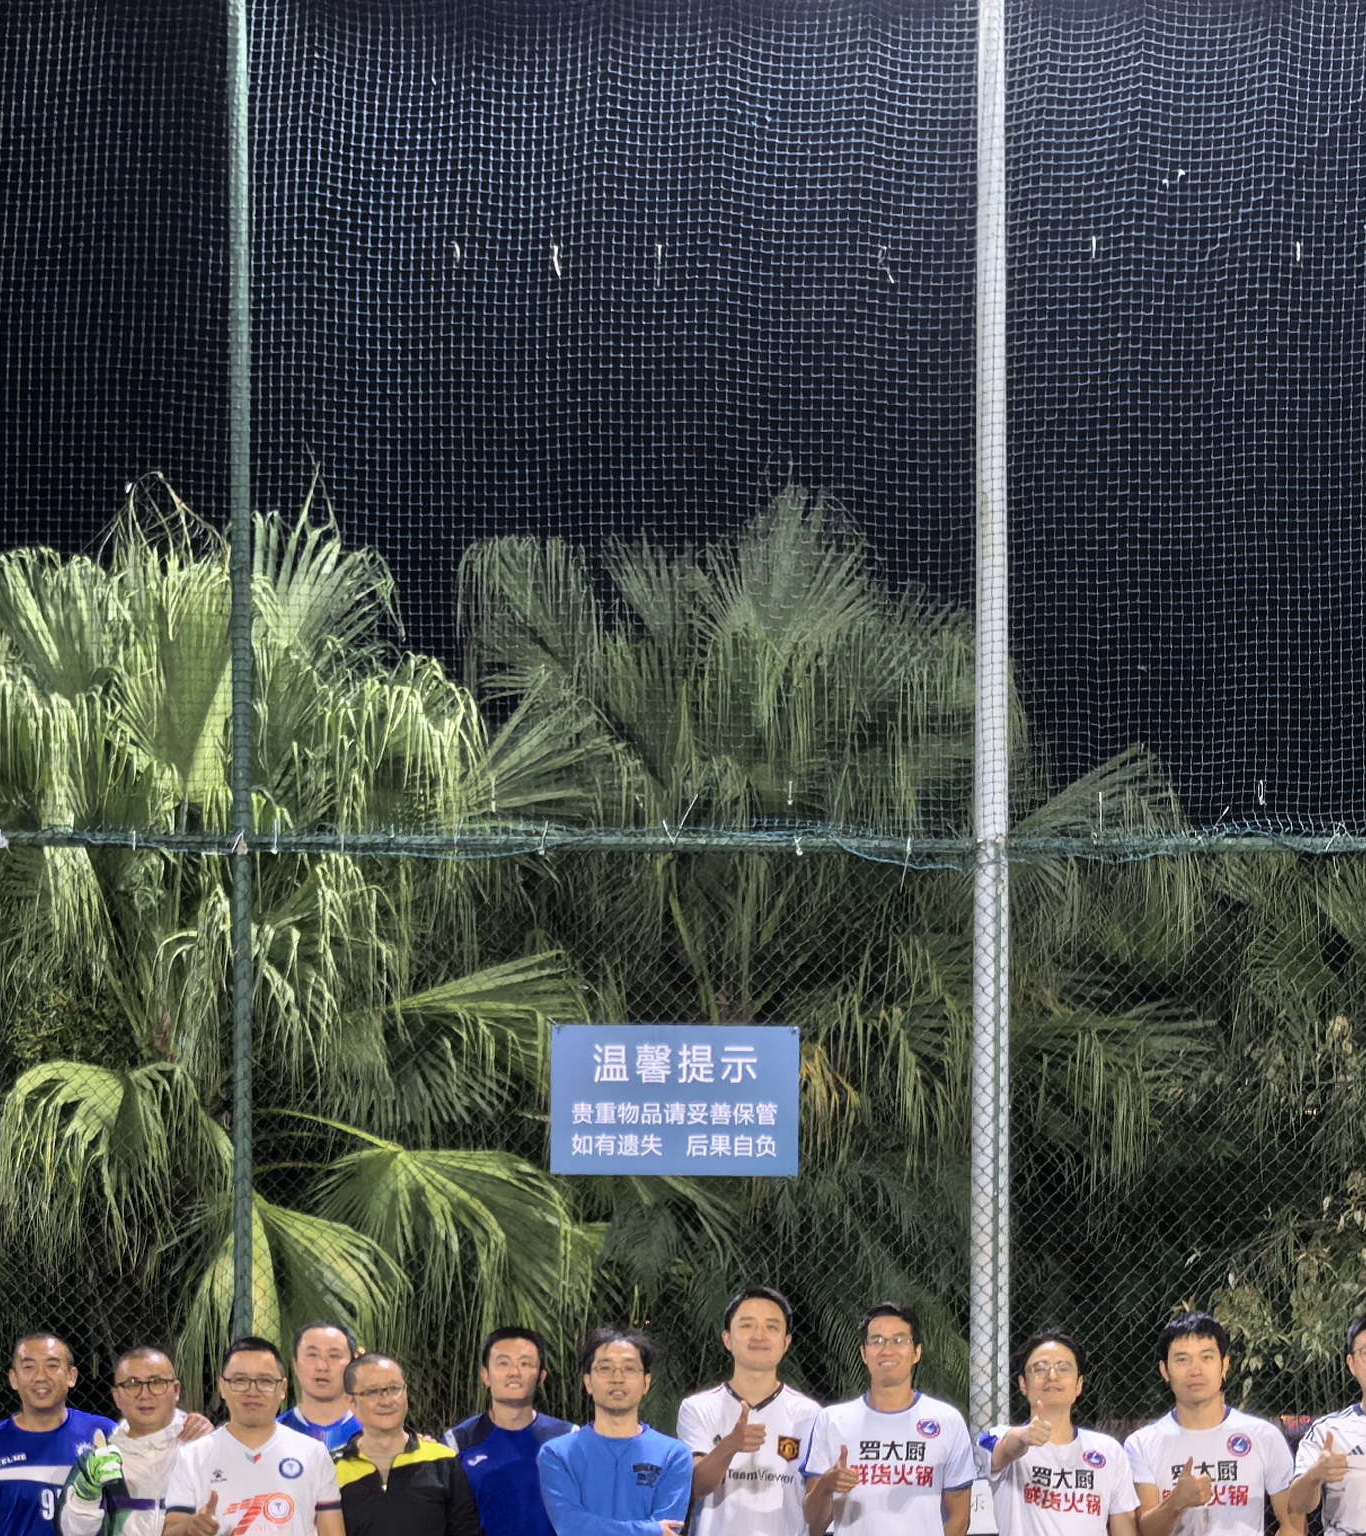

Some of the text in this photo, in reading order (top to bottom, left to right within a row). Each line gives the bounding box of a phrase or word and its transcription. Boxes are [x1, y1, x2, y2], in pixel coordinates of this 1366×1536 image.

[593, 1043, 758, 1084] 温馨提示
[571, 1102, 778, 1126] 贵重物品请妥善保管
[571, 1134, 777, 1158] 如有遗失 后果自负
[858, 1440, 926, 1462] 罗大厨
[1031, 1465, 1094, 1490] 罗大厨
